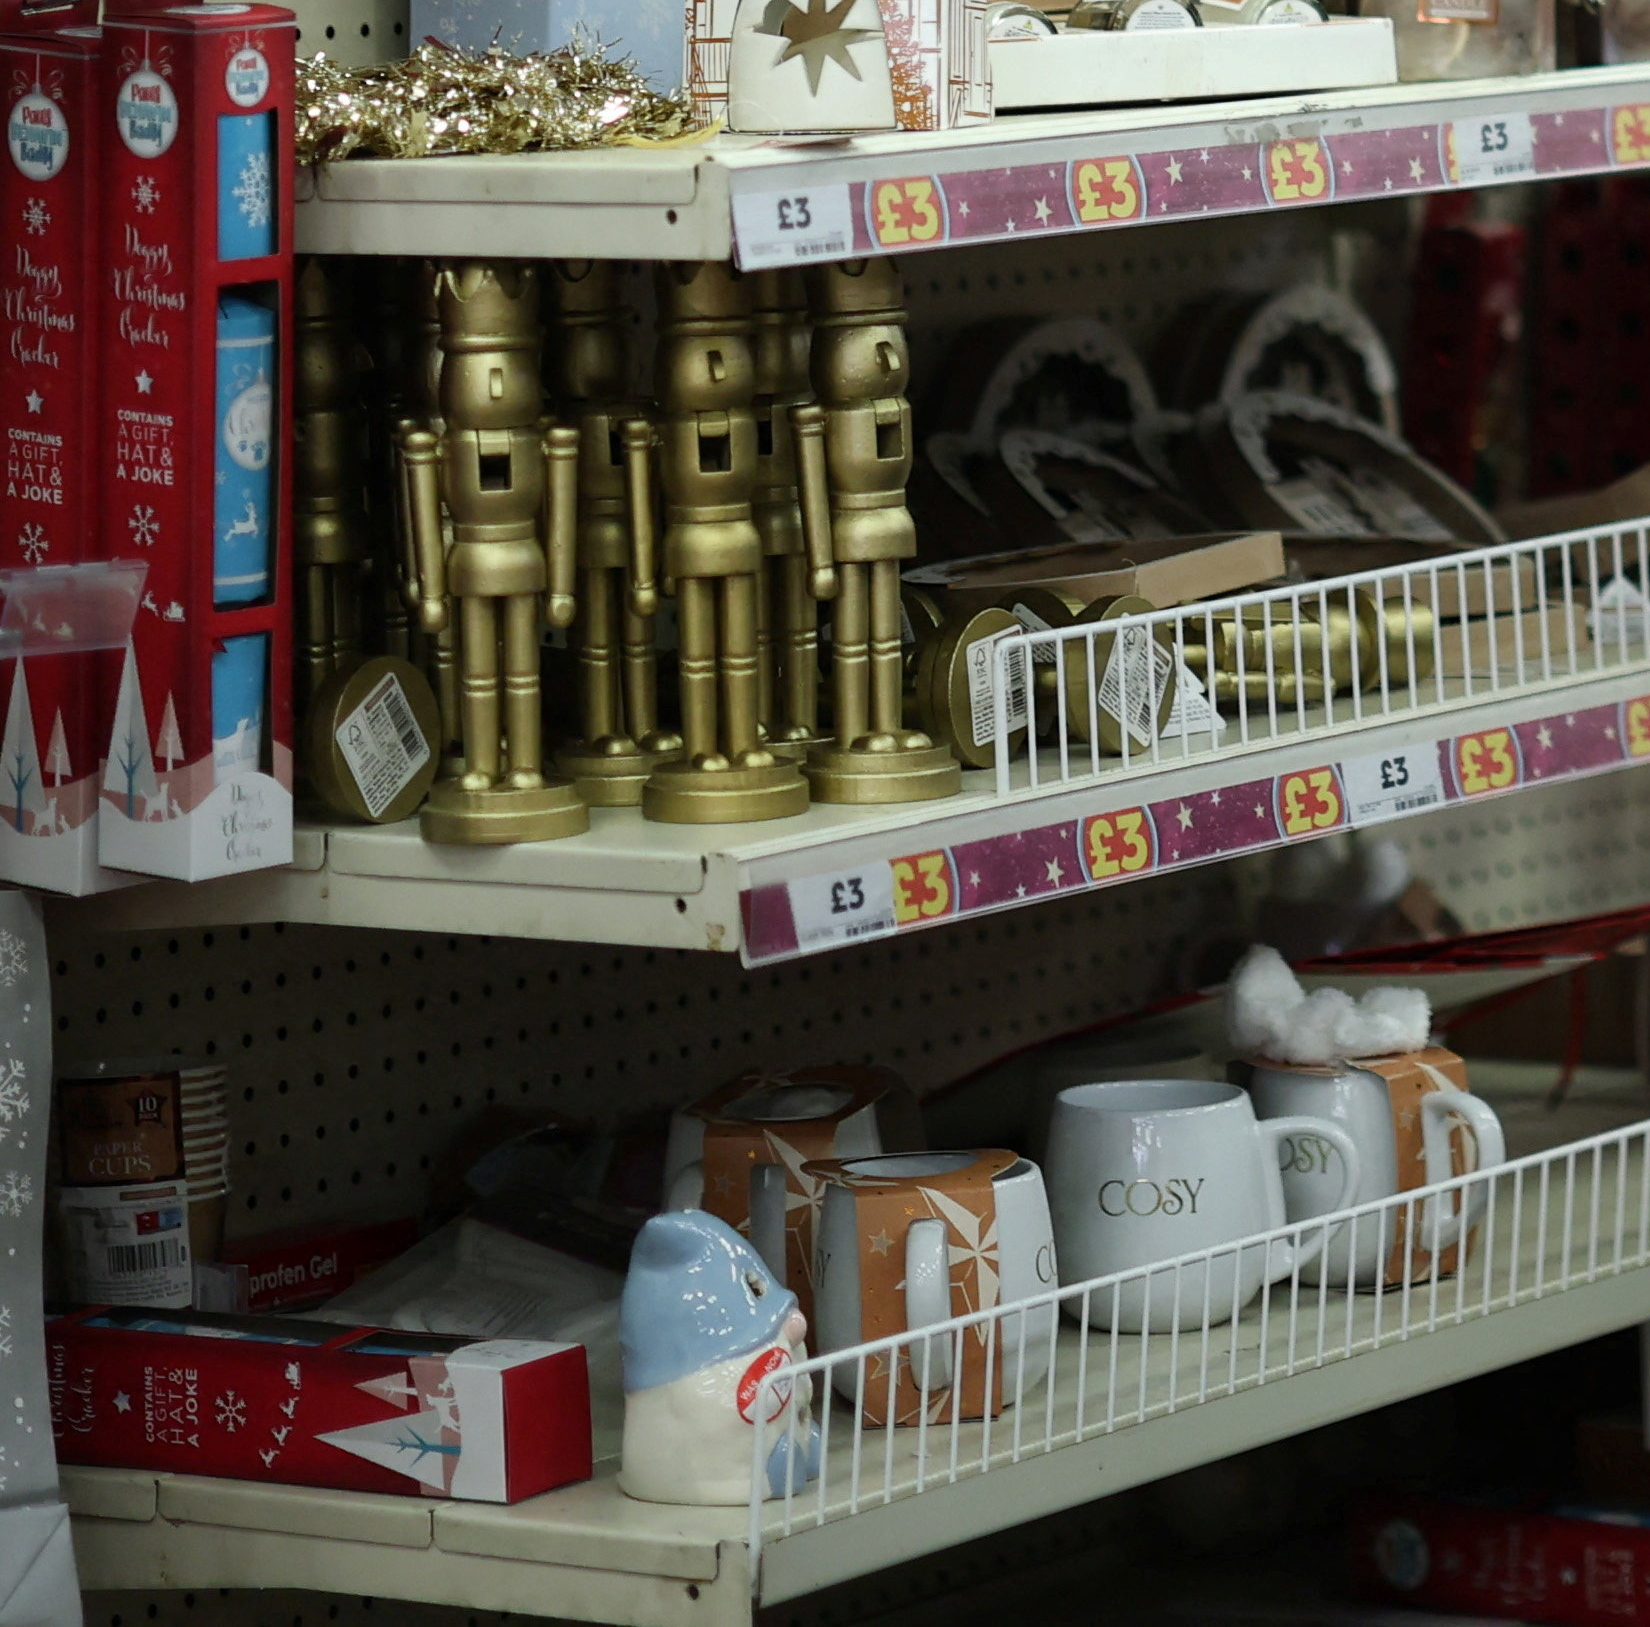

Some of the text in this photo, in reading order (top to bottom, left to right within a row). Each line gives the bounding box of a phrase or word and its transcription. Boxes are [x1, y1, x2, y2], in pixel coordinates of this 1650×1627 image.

[1479, 122, 1509, 154] £3
[1076, 159, 1138, 223] £3
[1268, 139, 1327, 201] £3
[776, 199, 812, 230] £3
[875, 180, 940, 243] £3
[16, 244, 63, 297] Doggy
[125, 223, 173, 276] Doggy
[4, 286, 76, 332] Christmas
[113, 265, 186, 311] Christmas
[10, 326, 60, 369] Cracker
[119, 306, 169, 350] Cracker
[7, 428, 63, 447] CONTAINS
[117, 409, 174, 427] CONTAINS
[118, 423, 174, 445] A GIFT,
[7, 460, 63, 487] HAT &
[9, 443, 63, 465] A GIFT,
[116, 464, 174, 486] A JOKE
[117, 442, 173, 467] HAT &
[7, 481, 63, 505] A JOKE
[1379, 755, 1410, 789] £3
[1459, 729, 1515, 795] £3
[1283, 767, 1341, 833] £3
[1089, 811, 1152, 879] £3
[830, 878, 865, 913] £3
[894, 852, 950, 923] £3
[138, 1096, 158, 1112] 10
[88, 1154, 152, 1176] CUPS
[1279, 1137, 1333, 1174] OSY
[1098, 1177, 1206, 1217] COSY
[249, 1253, 338, 1298] profen Gel
[143, 1365, 154, 1443] CONTAINS
[156, 1367, 168, 1443] A GIFT,
[169, 1367, 185, 1445] HAT &
[185, 1368, 200, 1448] A JOKE
